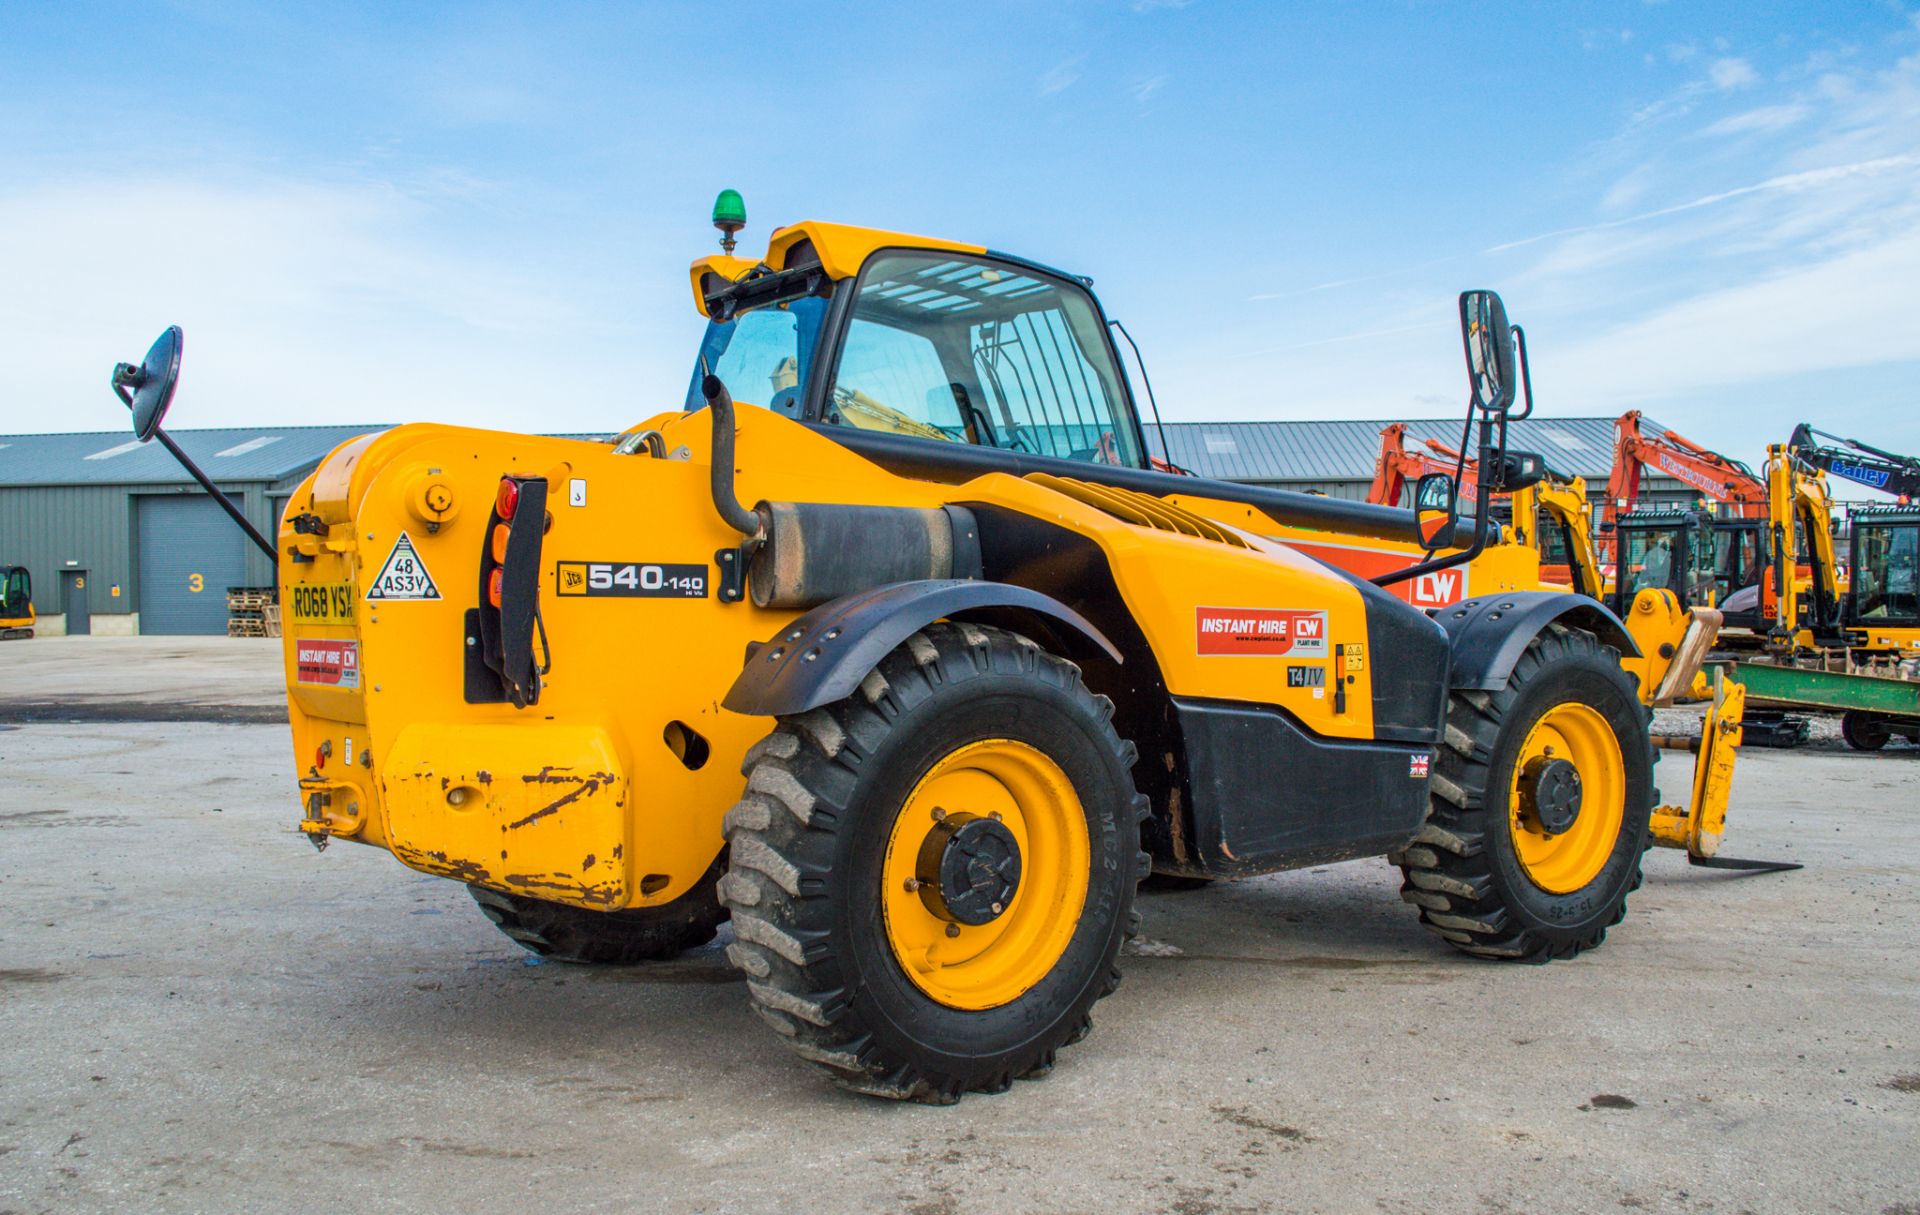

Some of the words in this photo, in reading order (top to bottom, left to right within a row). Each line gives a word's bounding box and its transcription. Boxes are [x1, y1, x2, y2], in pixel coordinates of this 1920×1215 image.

[1831, 460, 1890, 487] Bailey
[395, 559, 414, 574] 48
[75, 577, 85, 589] 3
[188, 573, 205, 592] 3
[384, 576, 425, 592] AS3Y
[565, 571, 583, 586] JCB
[588, 564, 704, 590] 540-140
[1201, 618, 1257, 633] INSTANT
[1257, 620, 1287, 634] HIRE
[1296, 619, 1319, 636] CW
[299, 649, 326, 663] INSTANT
[1288, 668, 1304, 685] T4
